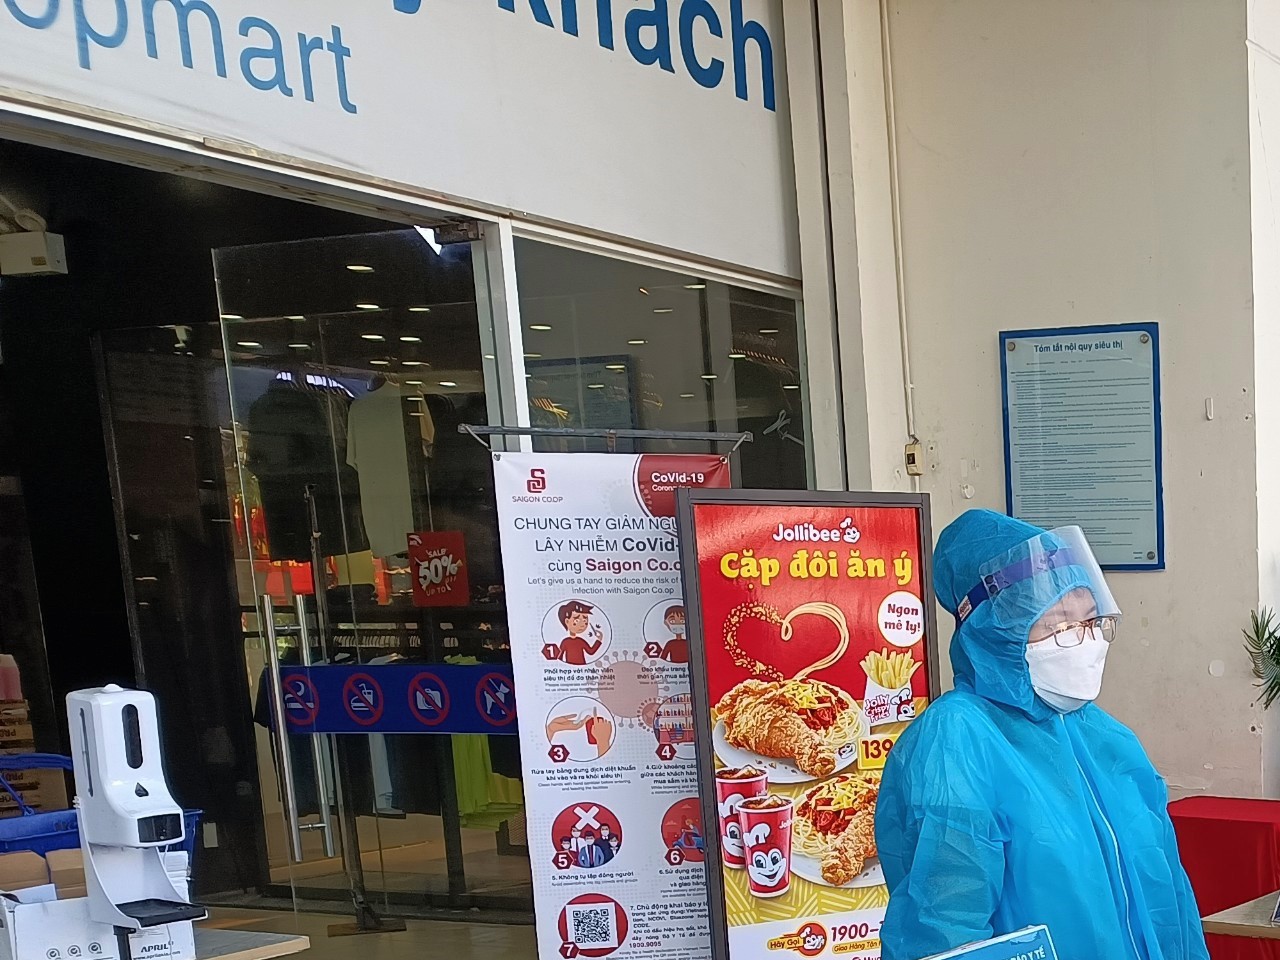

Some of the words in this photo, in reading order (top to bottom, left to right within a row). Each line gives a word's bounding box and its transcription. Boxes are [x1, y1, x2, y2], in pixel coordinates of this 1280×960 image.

[1078, 343, 1093, 352] quy
[651, 472, 705, 484] CoVid-19
[512, 495, 541, 504] SAIGON
[514, 517, 572, 530] CHUNG
[575, 517, 601, 530] TAY
[605, 514, 645, 530] GIẢM
[773, 522, 841, 542] Jollibee
[535, 536, 564, 552] LÂY
[418, 554, 458, 584] 50%
[548, 558, 582, 575] cùng
[585, 558, 642, 574] Saigon
[720, 549, 780, 589] Cặp
[789, 549, 839, 579] đôi
[846, 550, 886, 578] ăn
[893, 551, 913, 586] ý
[623, 587, 650, 596] Saigon
[887, 603, 919, 618] Ngon
[884, 619, 903, 631] mê
[546, 644, 555, 657] 1
[648, 643, 657, 656] 2
[864, 694, 889, 709] Jolly
[553, 746, 564, 761] 3
[661, 746, 672, 759] 4
[558, 854, 568, 868] 5
[670, 850, 680, 864] 6
[831, 921, 884, 942] 1900-
[140, 944, 169, 953] APRIL
[564, 943, 574, 957] 7
